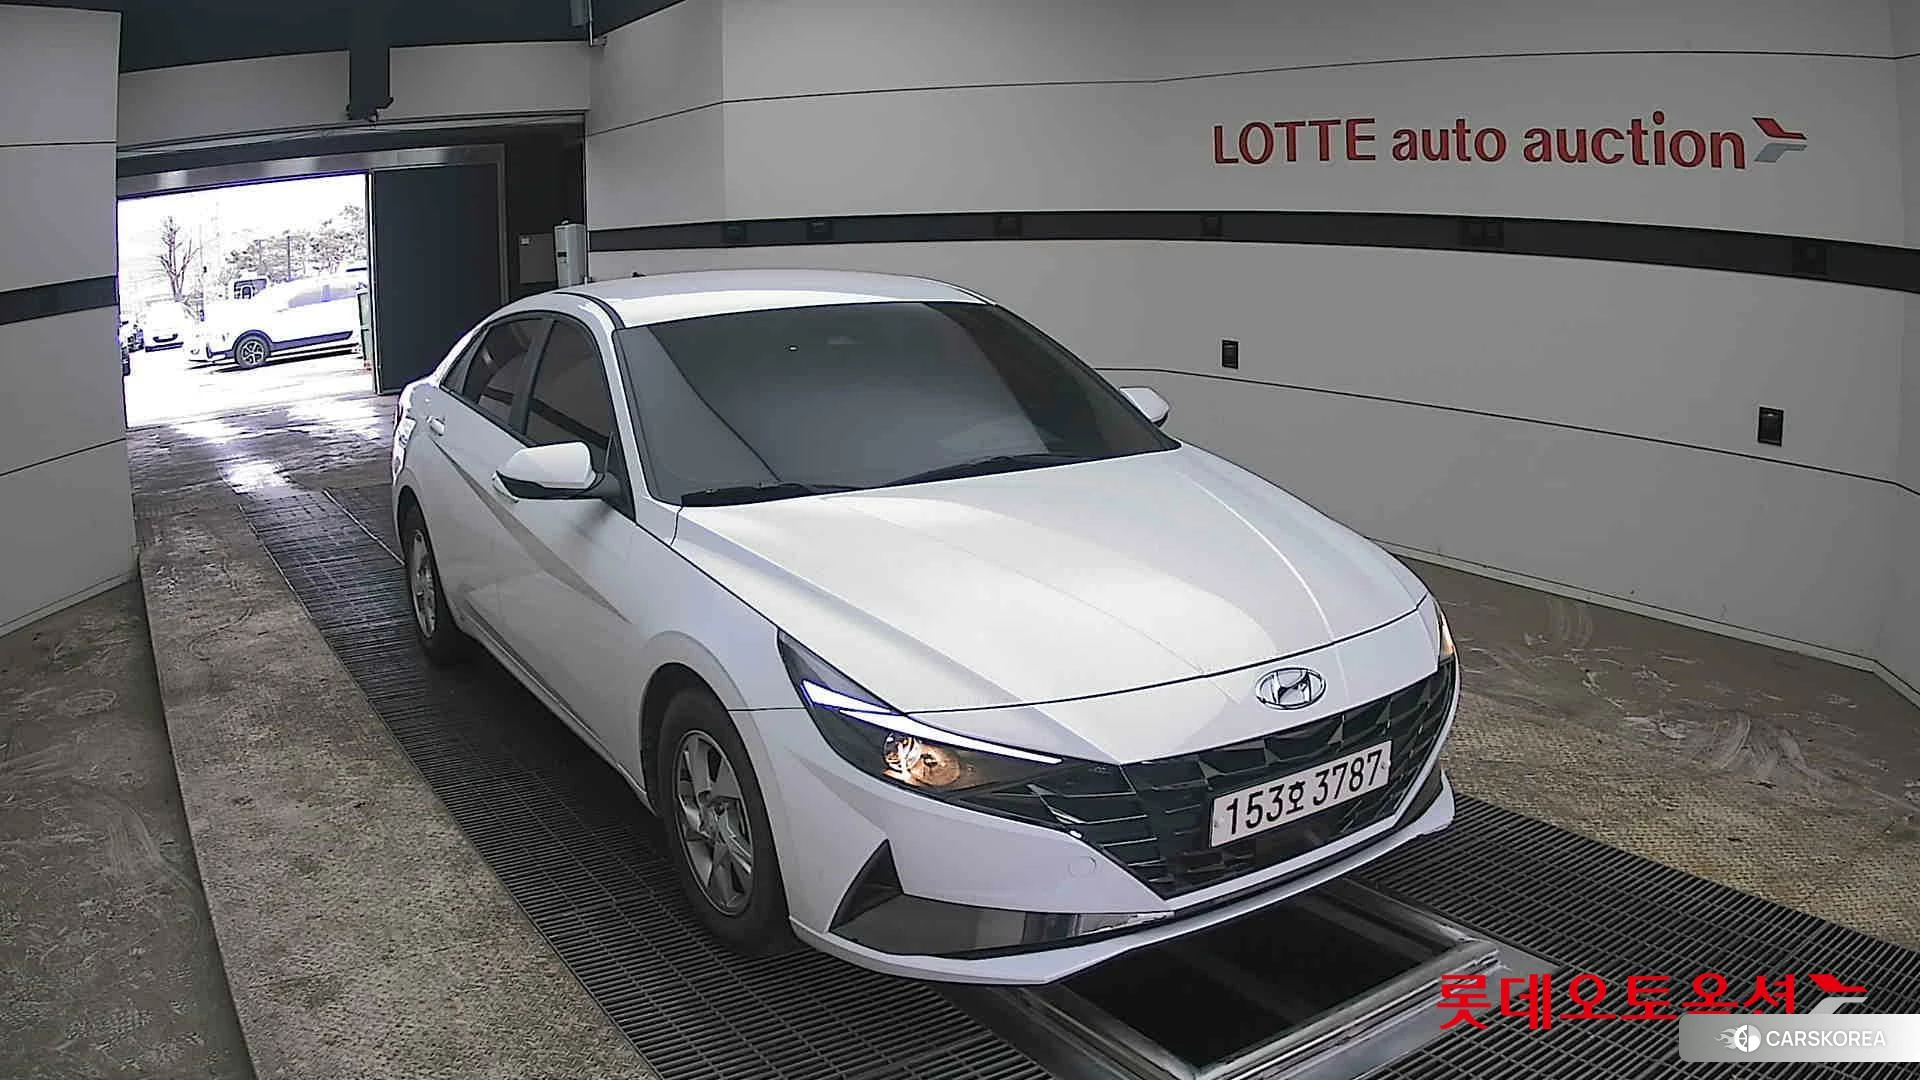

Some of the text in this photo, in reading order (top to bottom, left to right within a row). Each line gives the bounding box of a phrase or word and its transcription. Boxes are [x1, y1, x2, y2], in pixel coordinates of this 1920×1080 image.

[1212, 110, 1748, 170] LOTTE auto auction
[1225, 749, 1383, 835] 153호 3787
